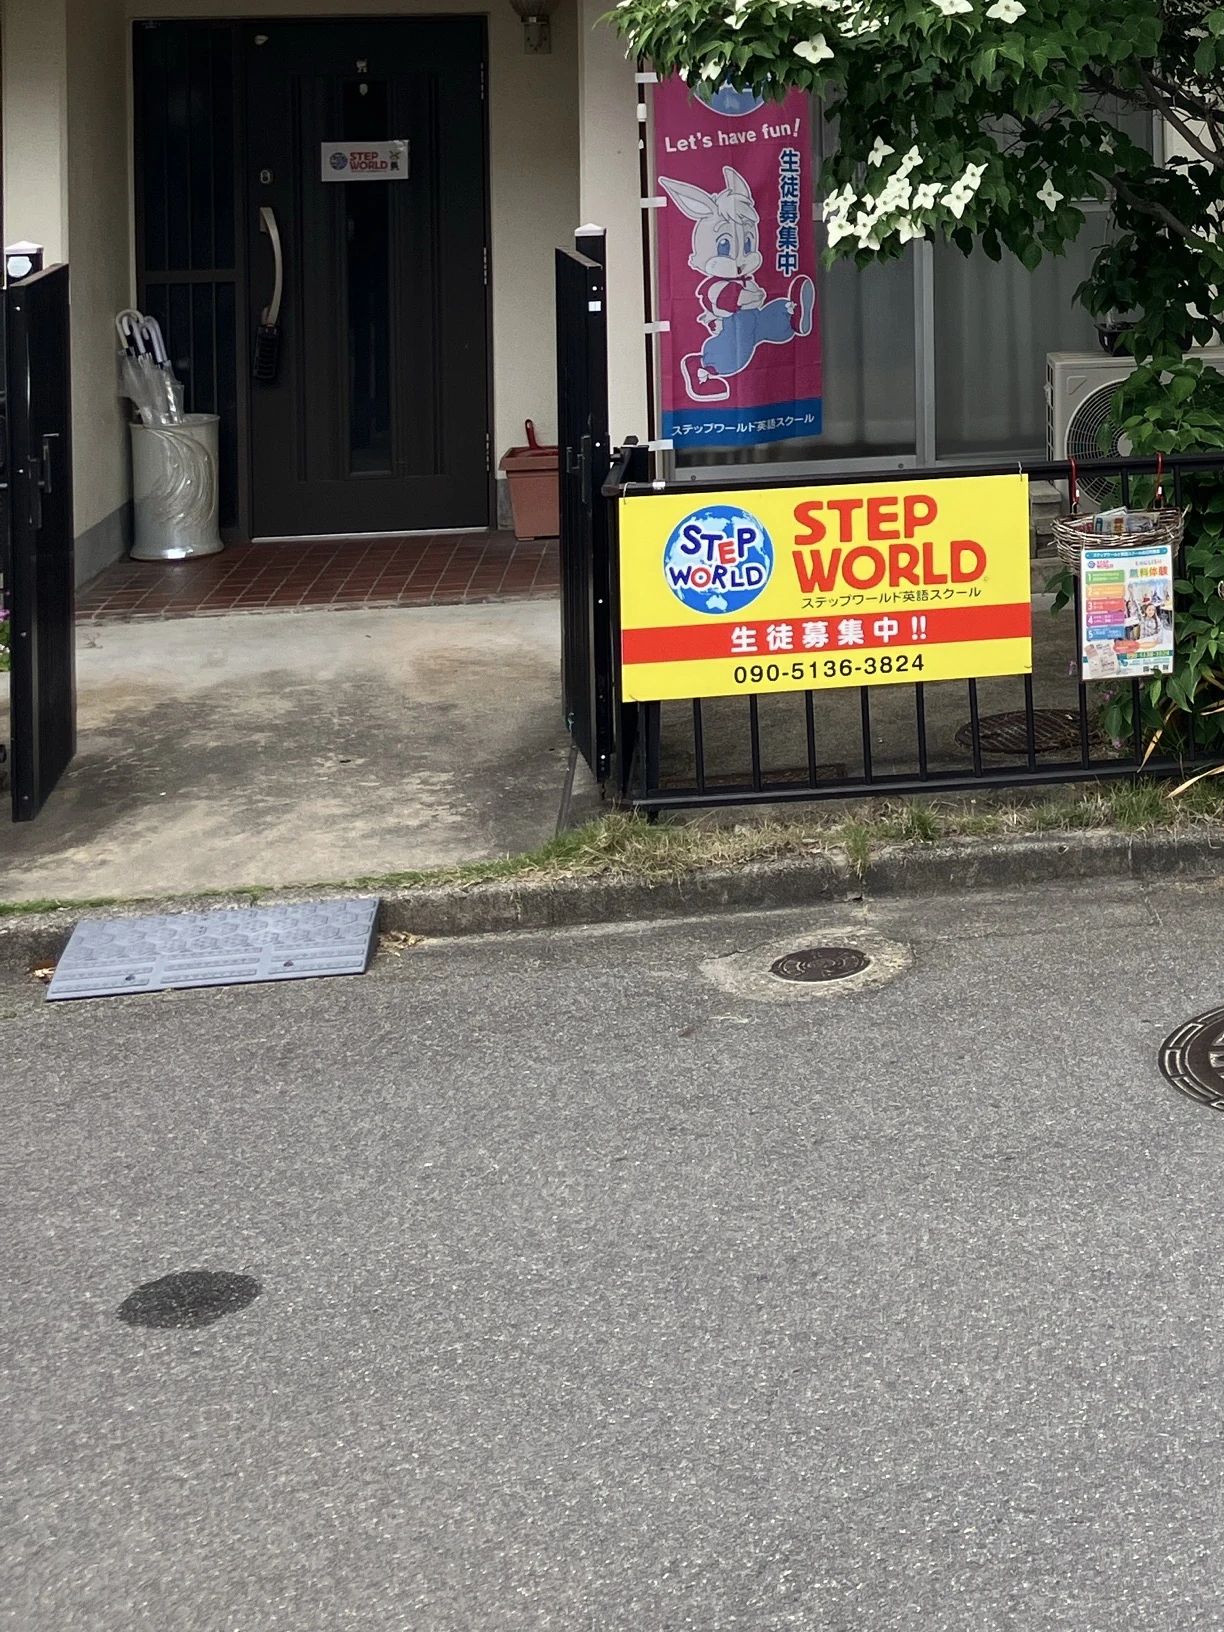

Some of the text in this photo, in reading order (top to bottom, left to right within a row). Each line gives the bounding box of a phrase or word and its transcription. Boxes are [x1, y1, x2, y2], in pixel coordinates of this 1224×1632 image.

[664, 118, 801, 153] Let's have fun!
[349, 151, 379, 161] STEP
[349, 160, 389, 170] WORLD
[775, 147, 800, 277] 生徒募集中
[671, 413, 815, 437] ステップワールド英語スクール
[792, 494, 939, 546] STEP
[680, 524, 757, 566] STEP
[669, 565, 764, 590] WORLD
[792, 539, 987, 593] WORLD
[801, 586, 981, 609] ステップワールド英語スクール
[733, 653, 925, 684] 090-5136-3824
